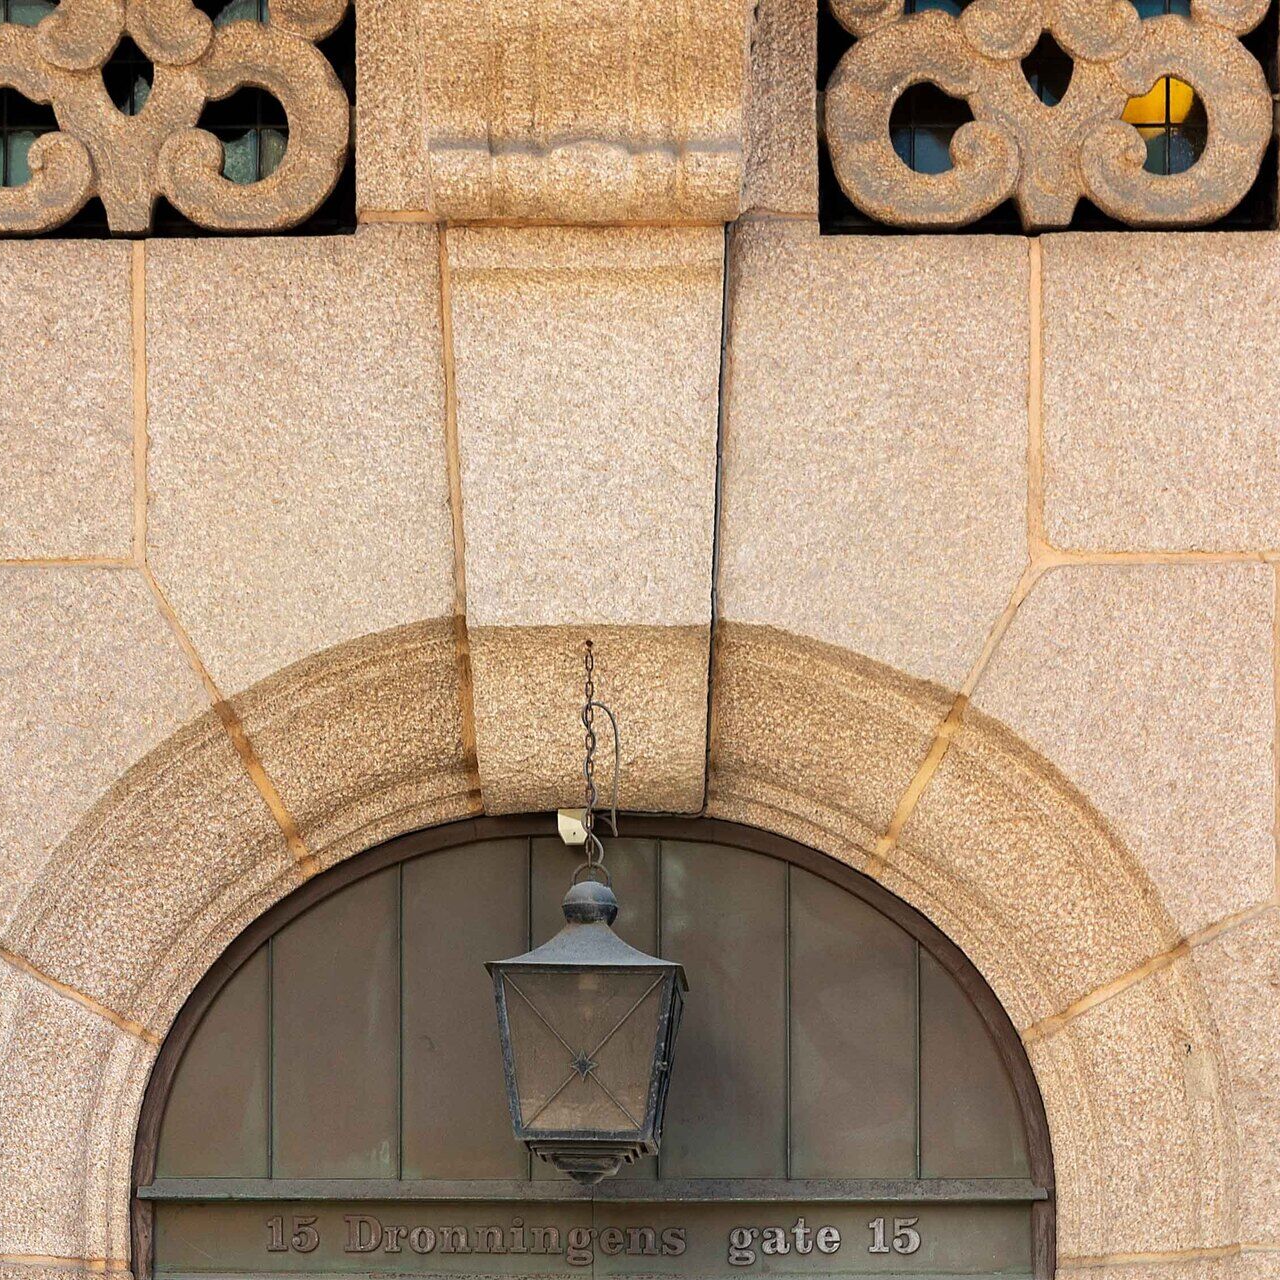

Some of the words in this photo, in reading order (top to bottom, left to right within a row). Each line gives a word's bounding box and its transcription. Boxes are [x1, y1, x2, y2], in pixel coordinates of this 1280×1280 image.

[266, 1214, 320, 1253] 15
[343, 1213, 688, 1267] Dronningens
[727, 1216, 842, 1265] gate
[868, 1216, 921, 1254] 15
